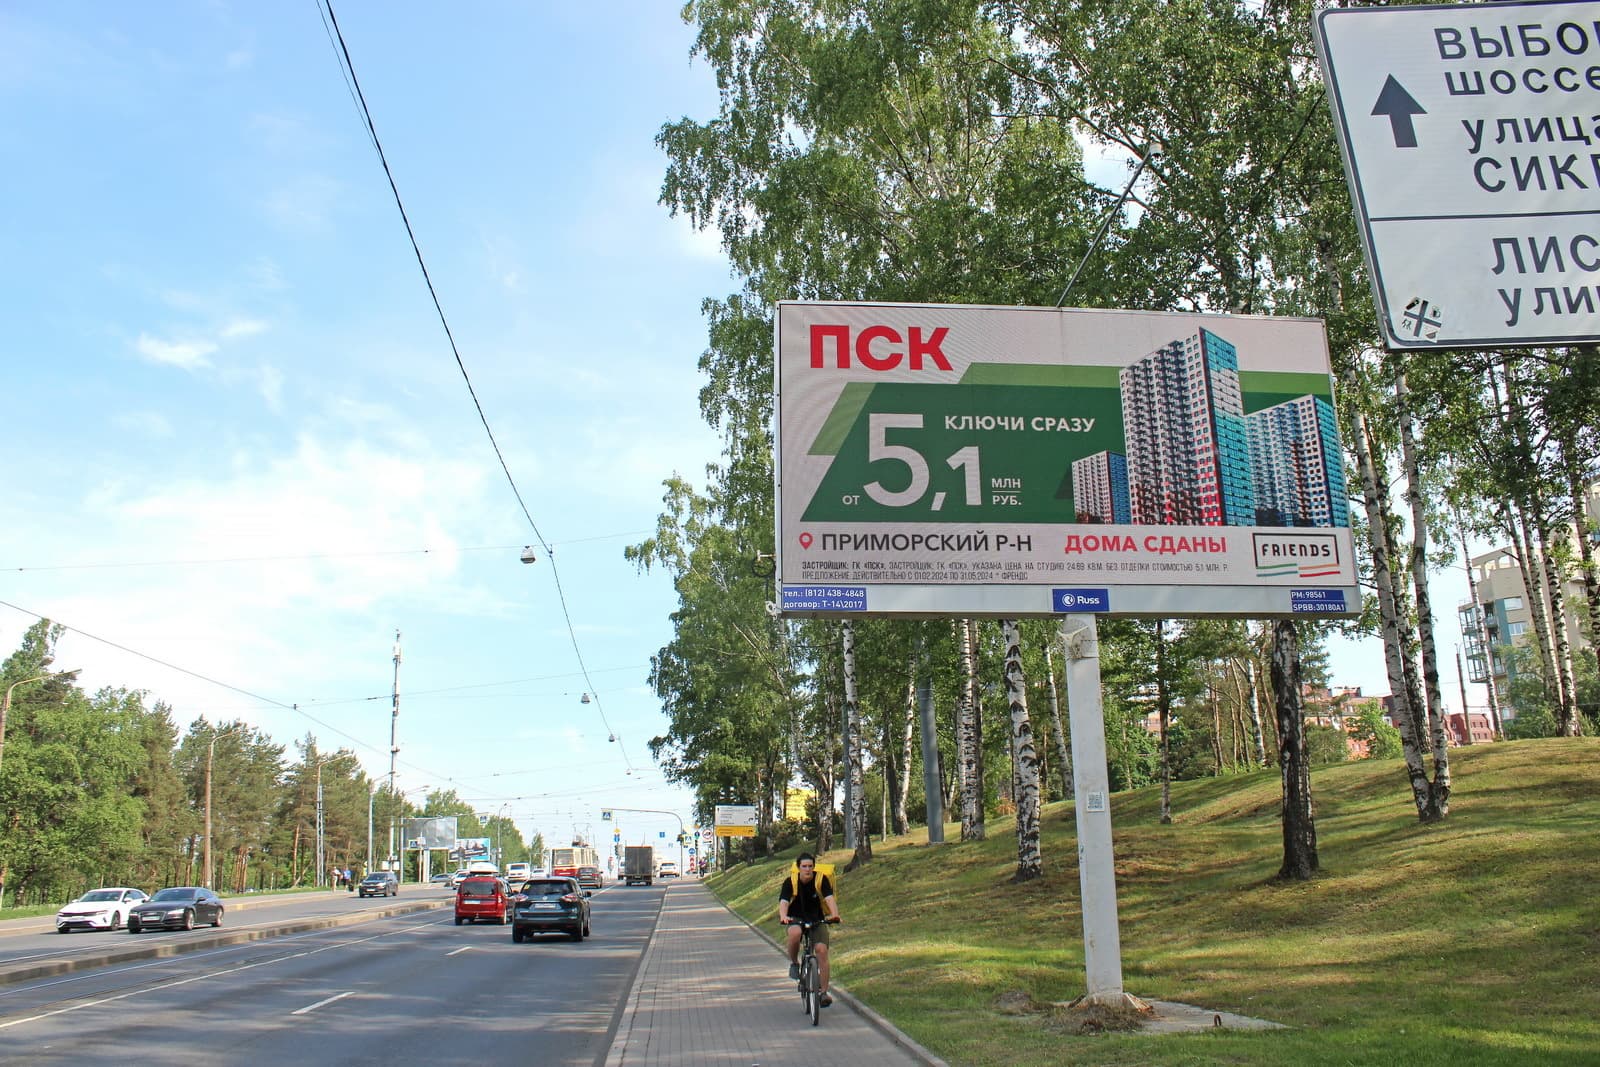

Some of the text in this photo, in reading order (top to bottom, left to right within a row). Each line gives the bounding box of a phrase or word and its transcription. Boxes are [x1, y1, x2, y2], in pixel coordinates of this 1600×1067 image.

[1434, 21, 1600, 60] ВЫБО
[1497, 285, 1600, 327] ули
[810, 324, 954, 371] ПСК
[944, 414, 1096, 433] КЛЮЧИ СРАЗУ
[862, 413, 983, 511] 5,1
[991, 477, 1022, 489] МЛН
[991, 494, 1023, 506] РУБ.
[822, 531, 1033, 552] ПРИМОРСКИЙ Р-Н
[1064, 534, 1227, 555] ДОМА СДАНЫ
[1261, 543, 1331, 557] FRIENDS
[802, 560, 849, 570] ЗАСТРОЙЩИК:
[852, 561, 861, 570] ГК
[972, 562, 1002, 571] УКАЗАНА
[1004, 562, 1022, 571] ЦЕНА
[1025, 562, 1035, 571] НА
[1037, 563, 1065, 572] СТУДИЮ
[1106, 563, 1118, 571] БЕЗ
[1121, 563, 1150, 572] ОТДЕЛКИ
[1152, 563, 1193, 572] СТОИМОСТЬЮ
[802, 571, 850, 580] ПРЕДЛОЖЕНИЕ
[852, 571, 906, 580] ДЕЙСТВИТЕЛЬНО
[949, 572, 959, 580] ПО
[1001, 572, 1028, 581] ФРЕНДС
[805, 588, 825, 598] (812)
[827, 589, 865, 598] 438-4848
[1077, 595, 1100, 605] Russ
[783, 601, 821, 610] договор:
